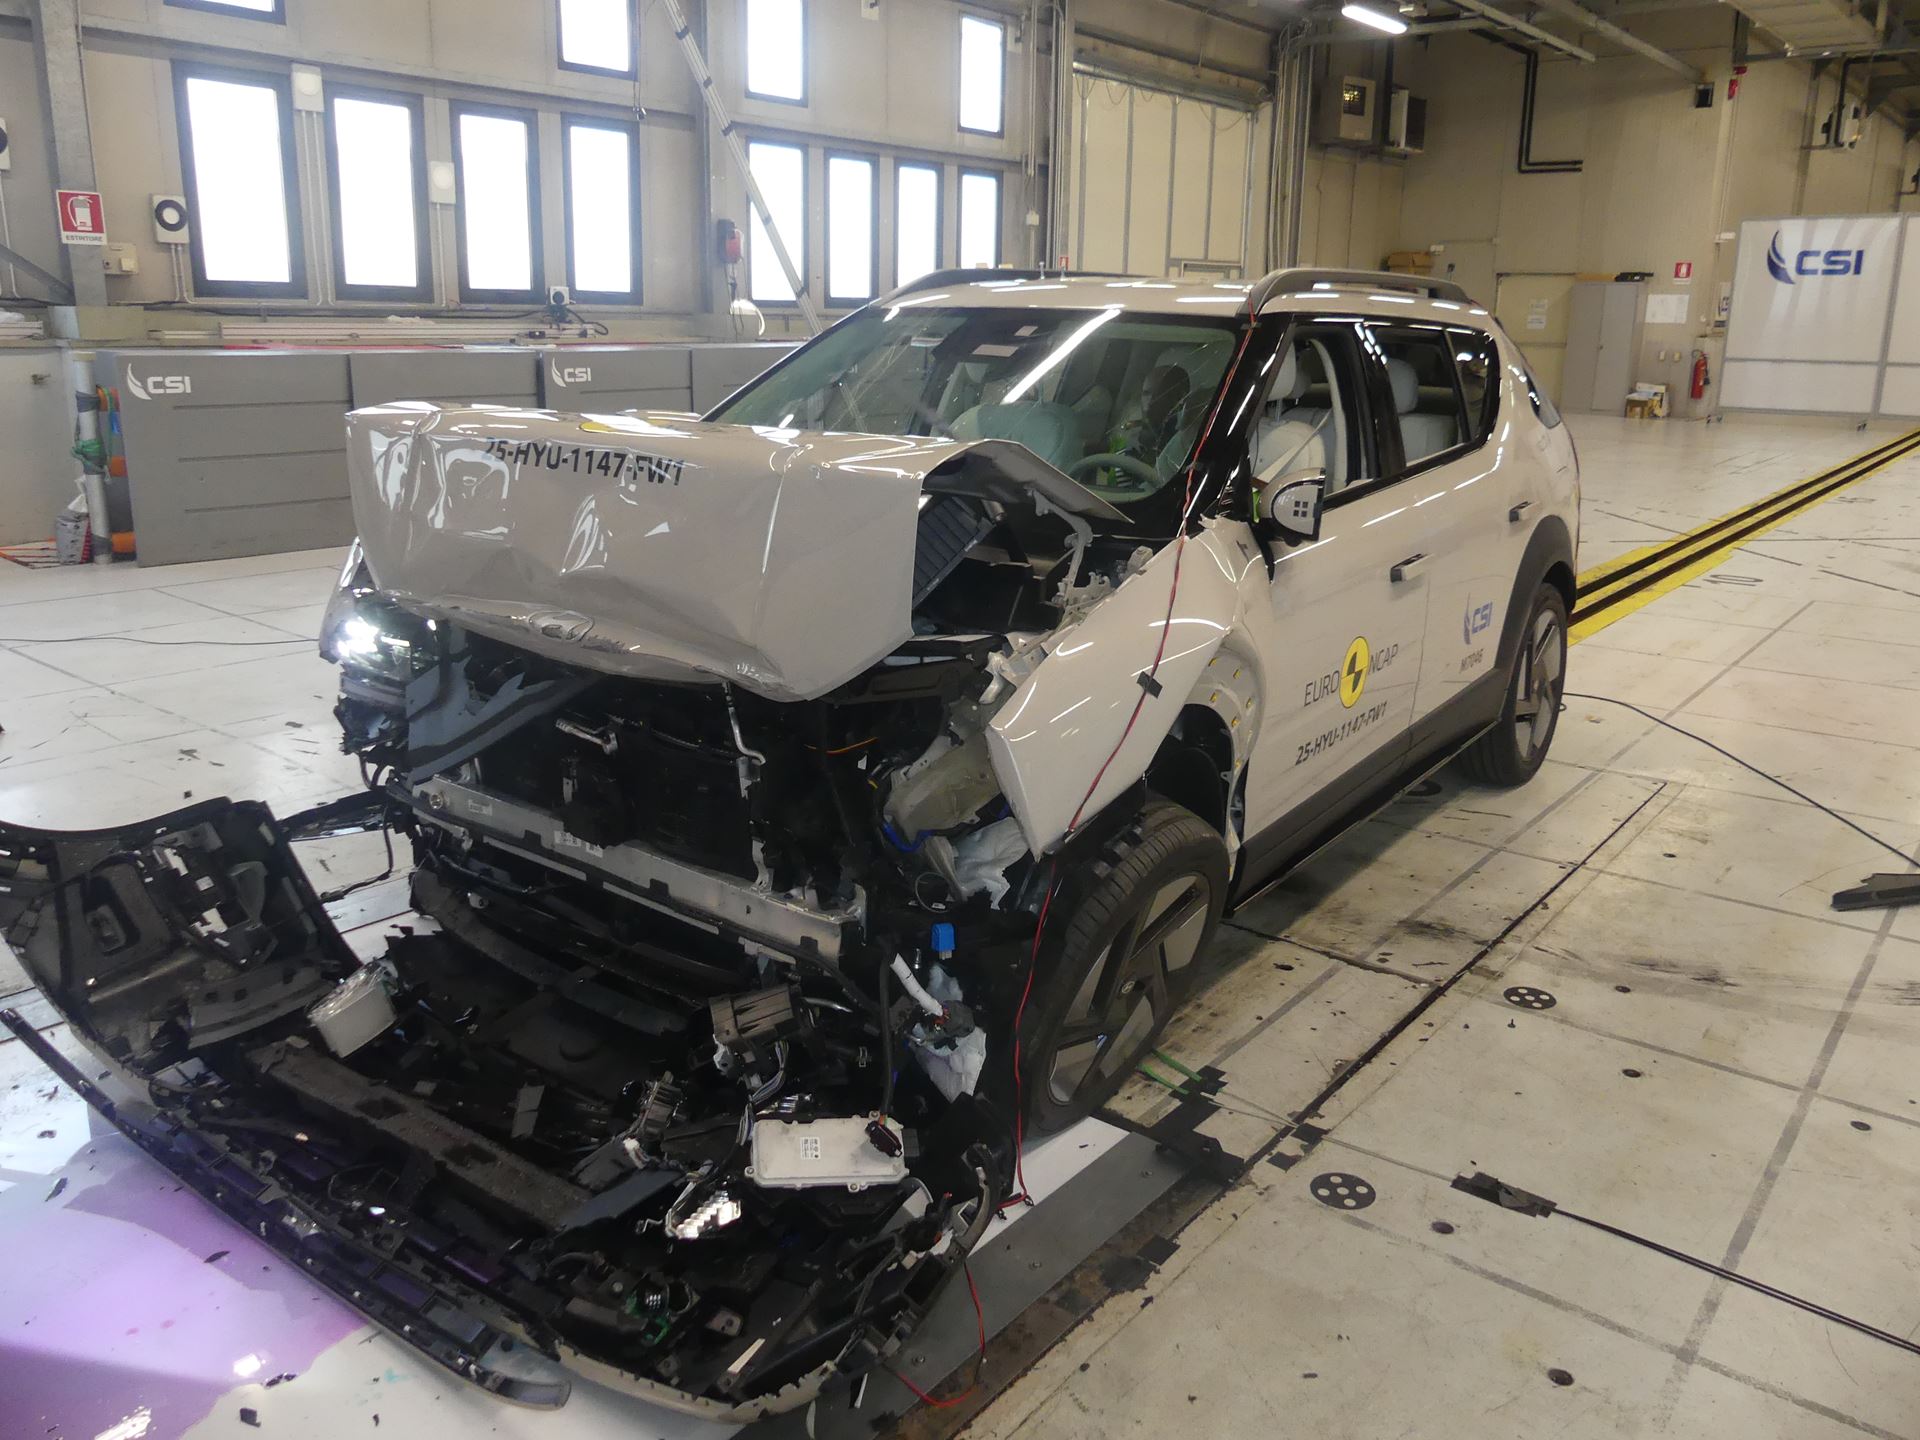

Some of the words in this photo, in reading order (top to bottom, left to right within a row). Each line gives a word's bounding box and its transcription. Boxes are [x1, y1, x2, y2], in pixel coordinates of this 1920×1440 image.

[1795, 249, 1865, 276] CSI
[147, 376, 192, 394] CSI
[564, 367, 592, 383] CSI
[485, 437, 684, 486] 25-HYU-1147-FW1
[1471, 602, 1493, 634] CSI
[1304, 670, 1340, 707] EURO
[1369, 643, 1399, 675] NCAP
[1295, 701, 1388, 766] 25-HYU-1147-FW1
